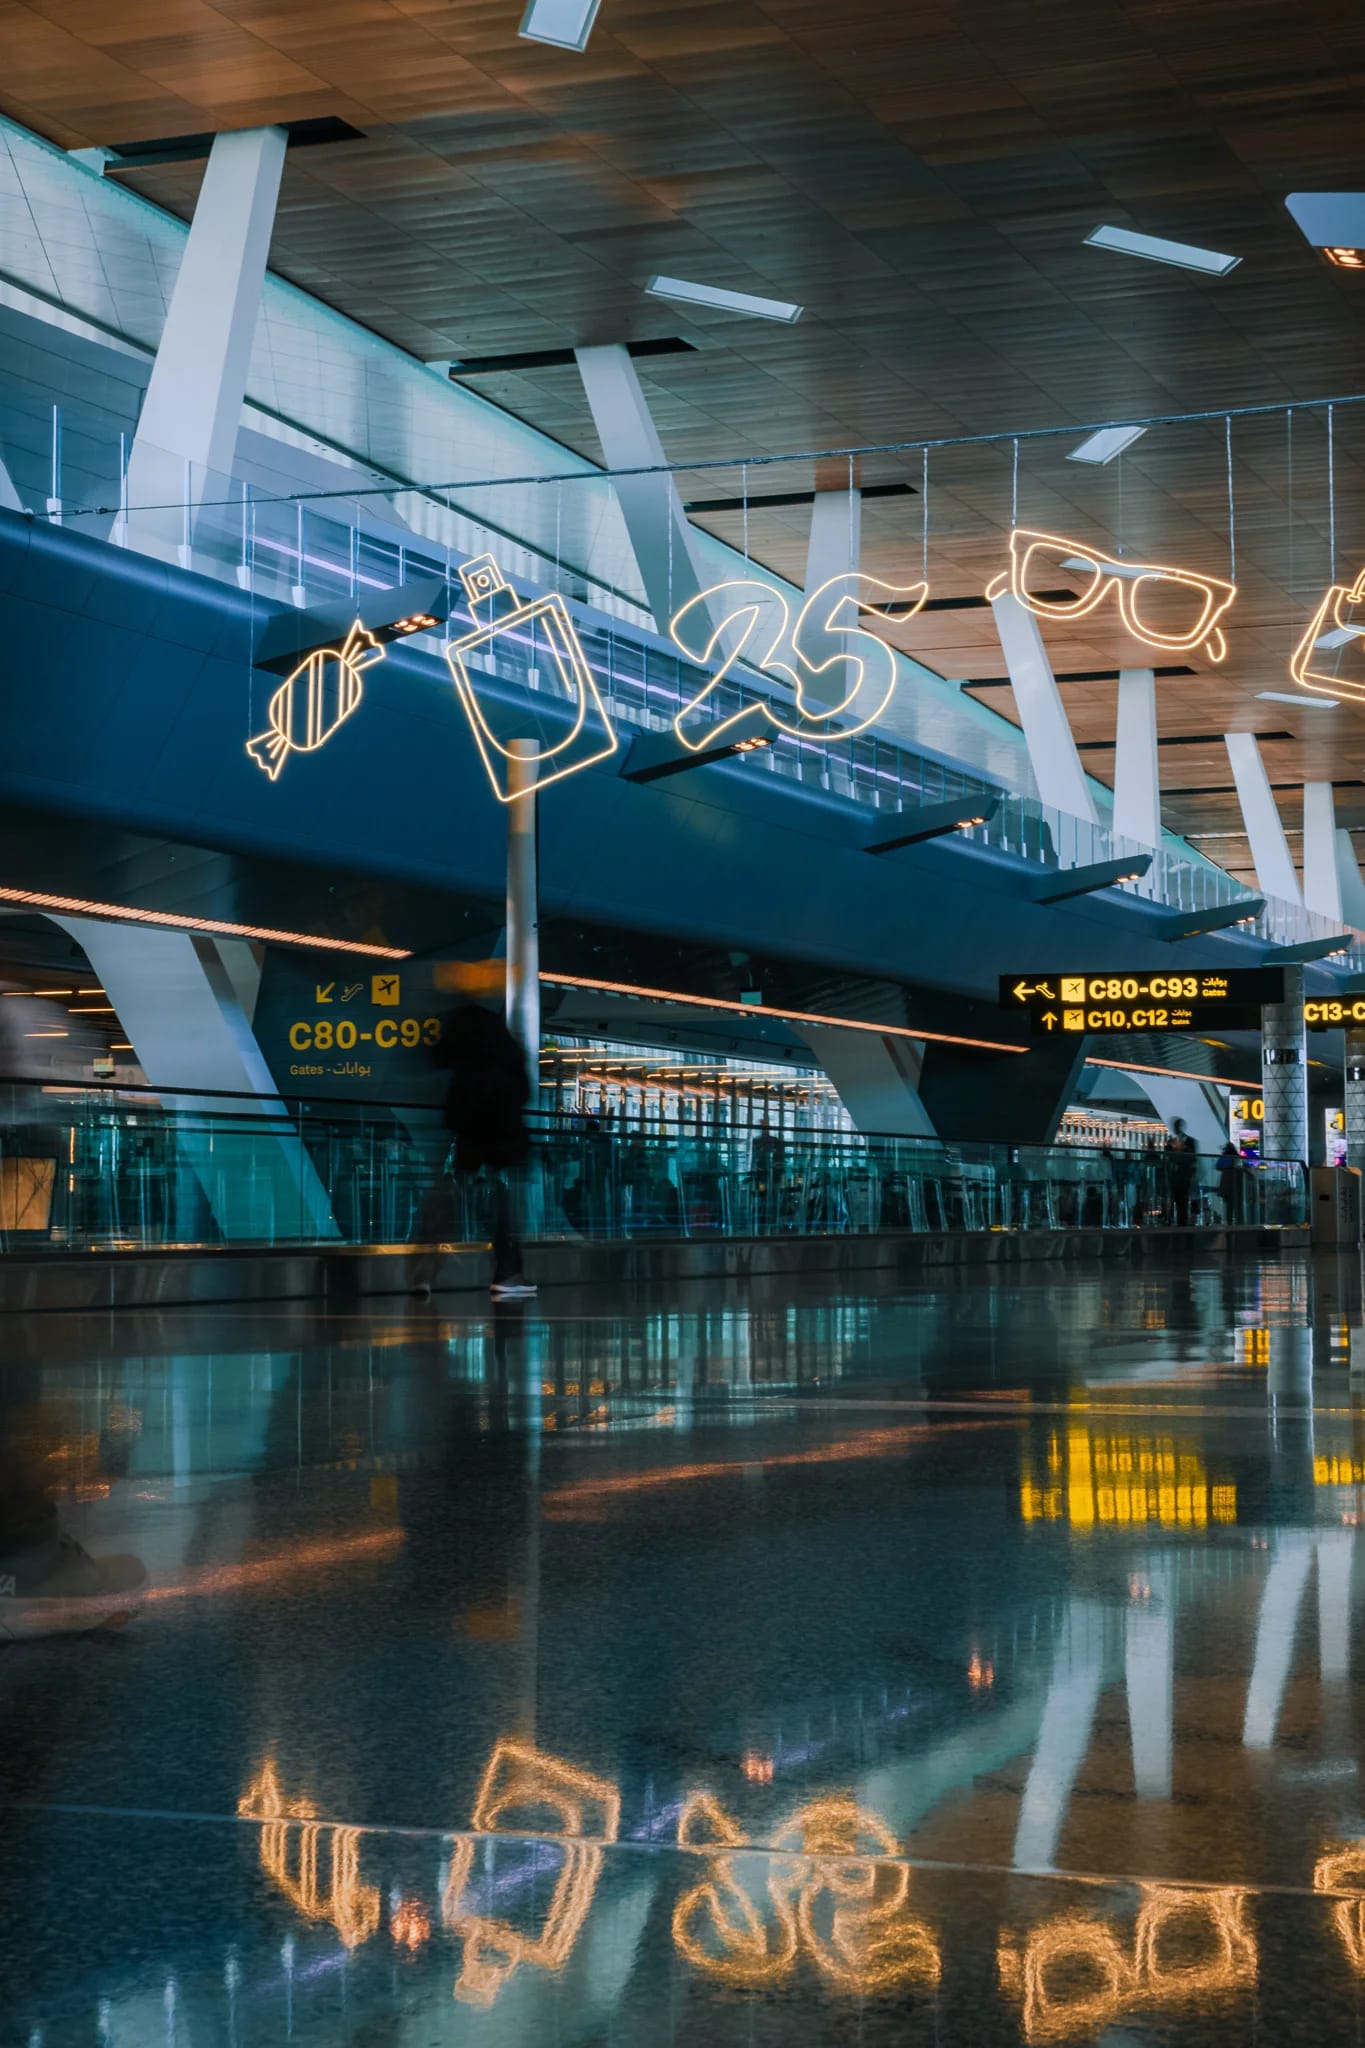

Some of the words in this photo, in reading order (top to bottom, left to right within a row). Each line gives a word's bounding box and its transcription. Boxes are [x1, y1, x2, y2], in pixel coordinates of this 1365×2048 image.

[670, 573, 929, 751] 25
[1088, 977, 1199, 1000] C80-C93
[1201, 988, 1227, 998] Gates
[289, 1018, 441, 1051] C80-C93
[289, 1064, 324, 1076] Gates
[332, 1061, 371, 1078] بوابات
